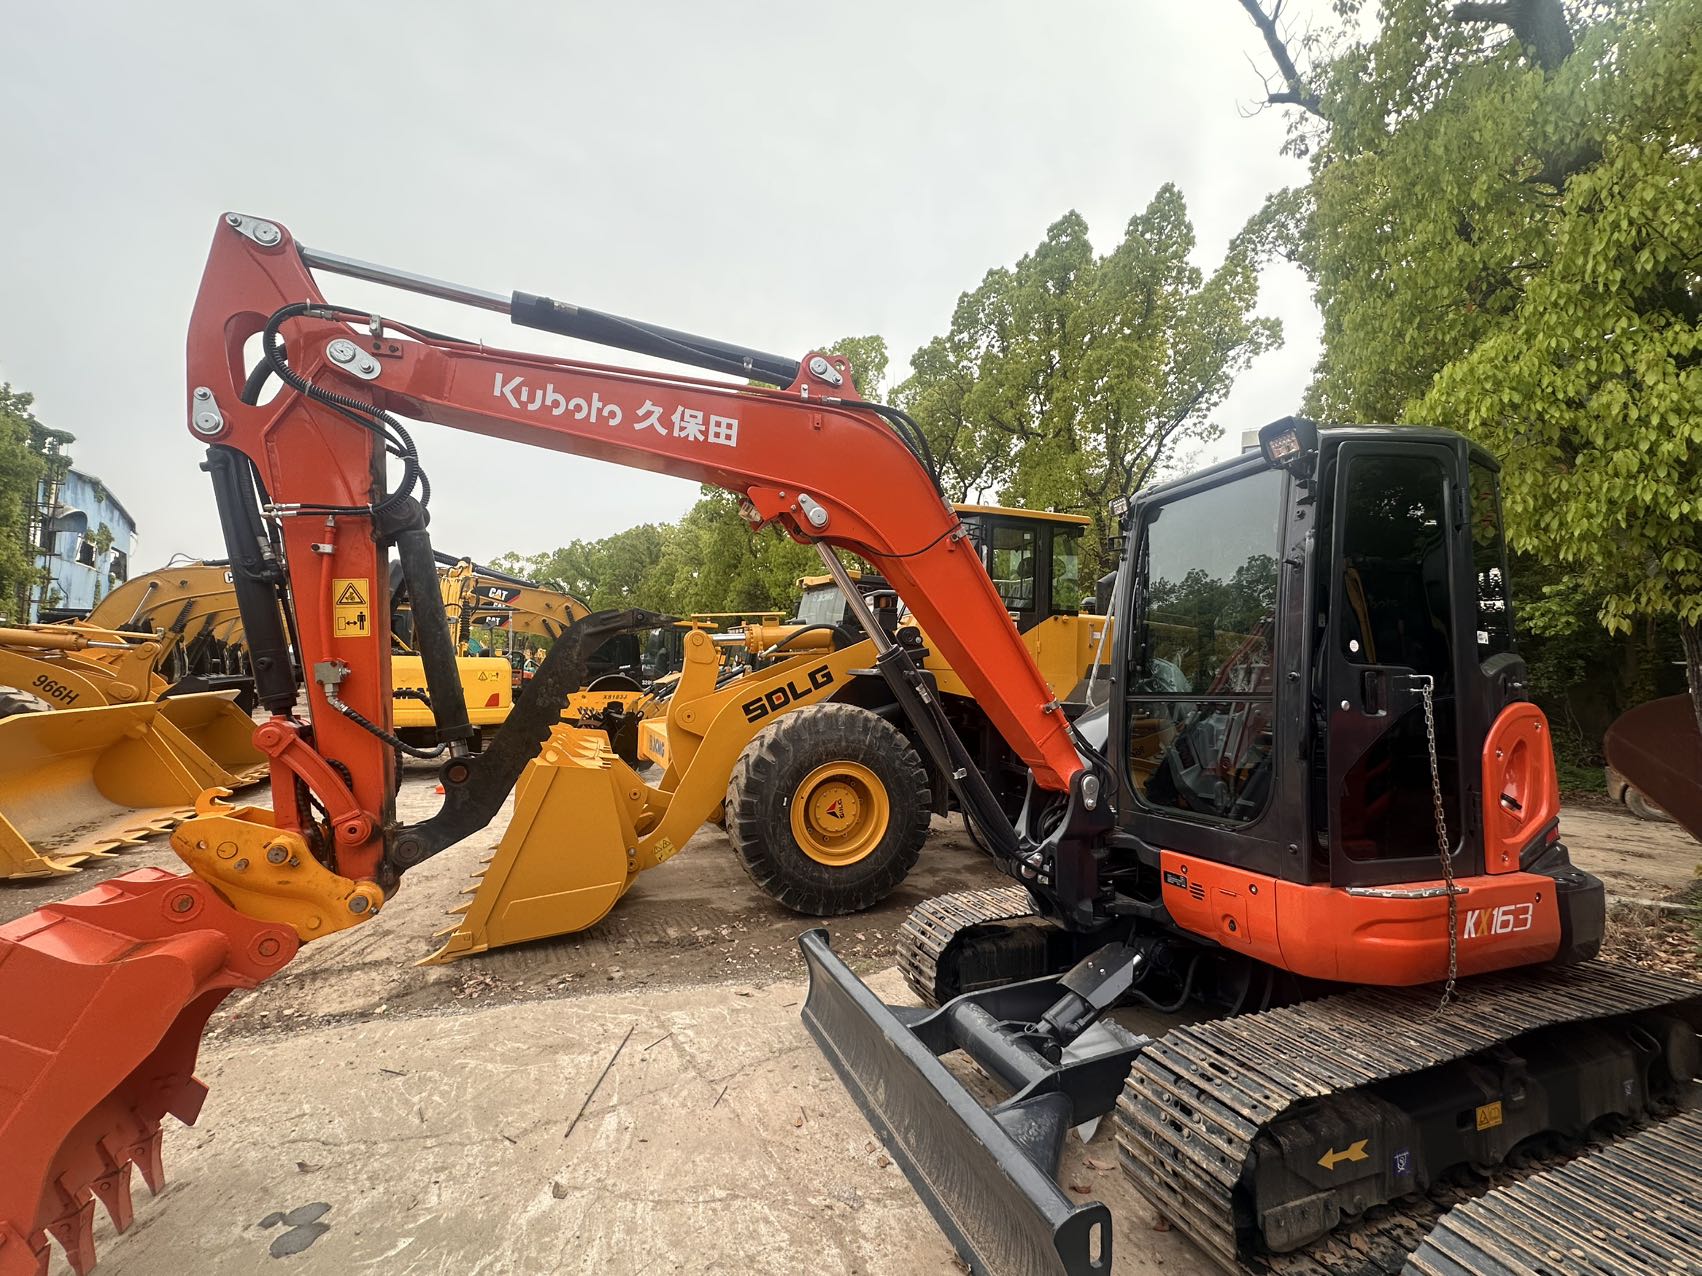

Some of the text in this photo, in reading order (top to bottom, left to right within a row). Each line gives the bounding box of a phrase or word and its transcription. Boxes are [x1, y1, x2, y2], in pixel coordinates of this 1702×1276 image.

[493, 372, 739, 448] Kubota 久保田
[488, 587, 508, 601] CAT
[32, 674, 80, 705] 966H
[741, 664, 834, 723] SDLG
[1463, 903, 1533, 939] KX163
